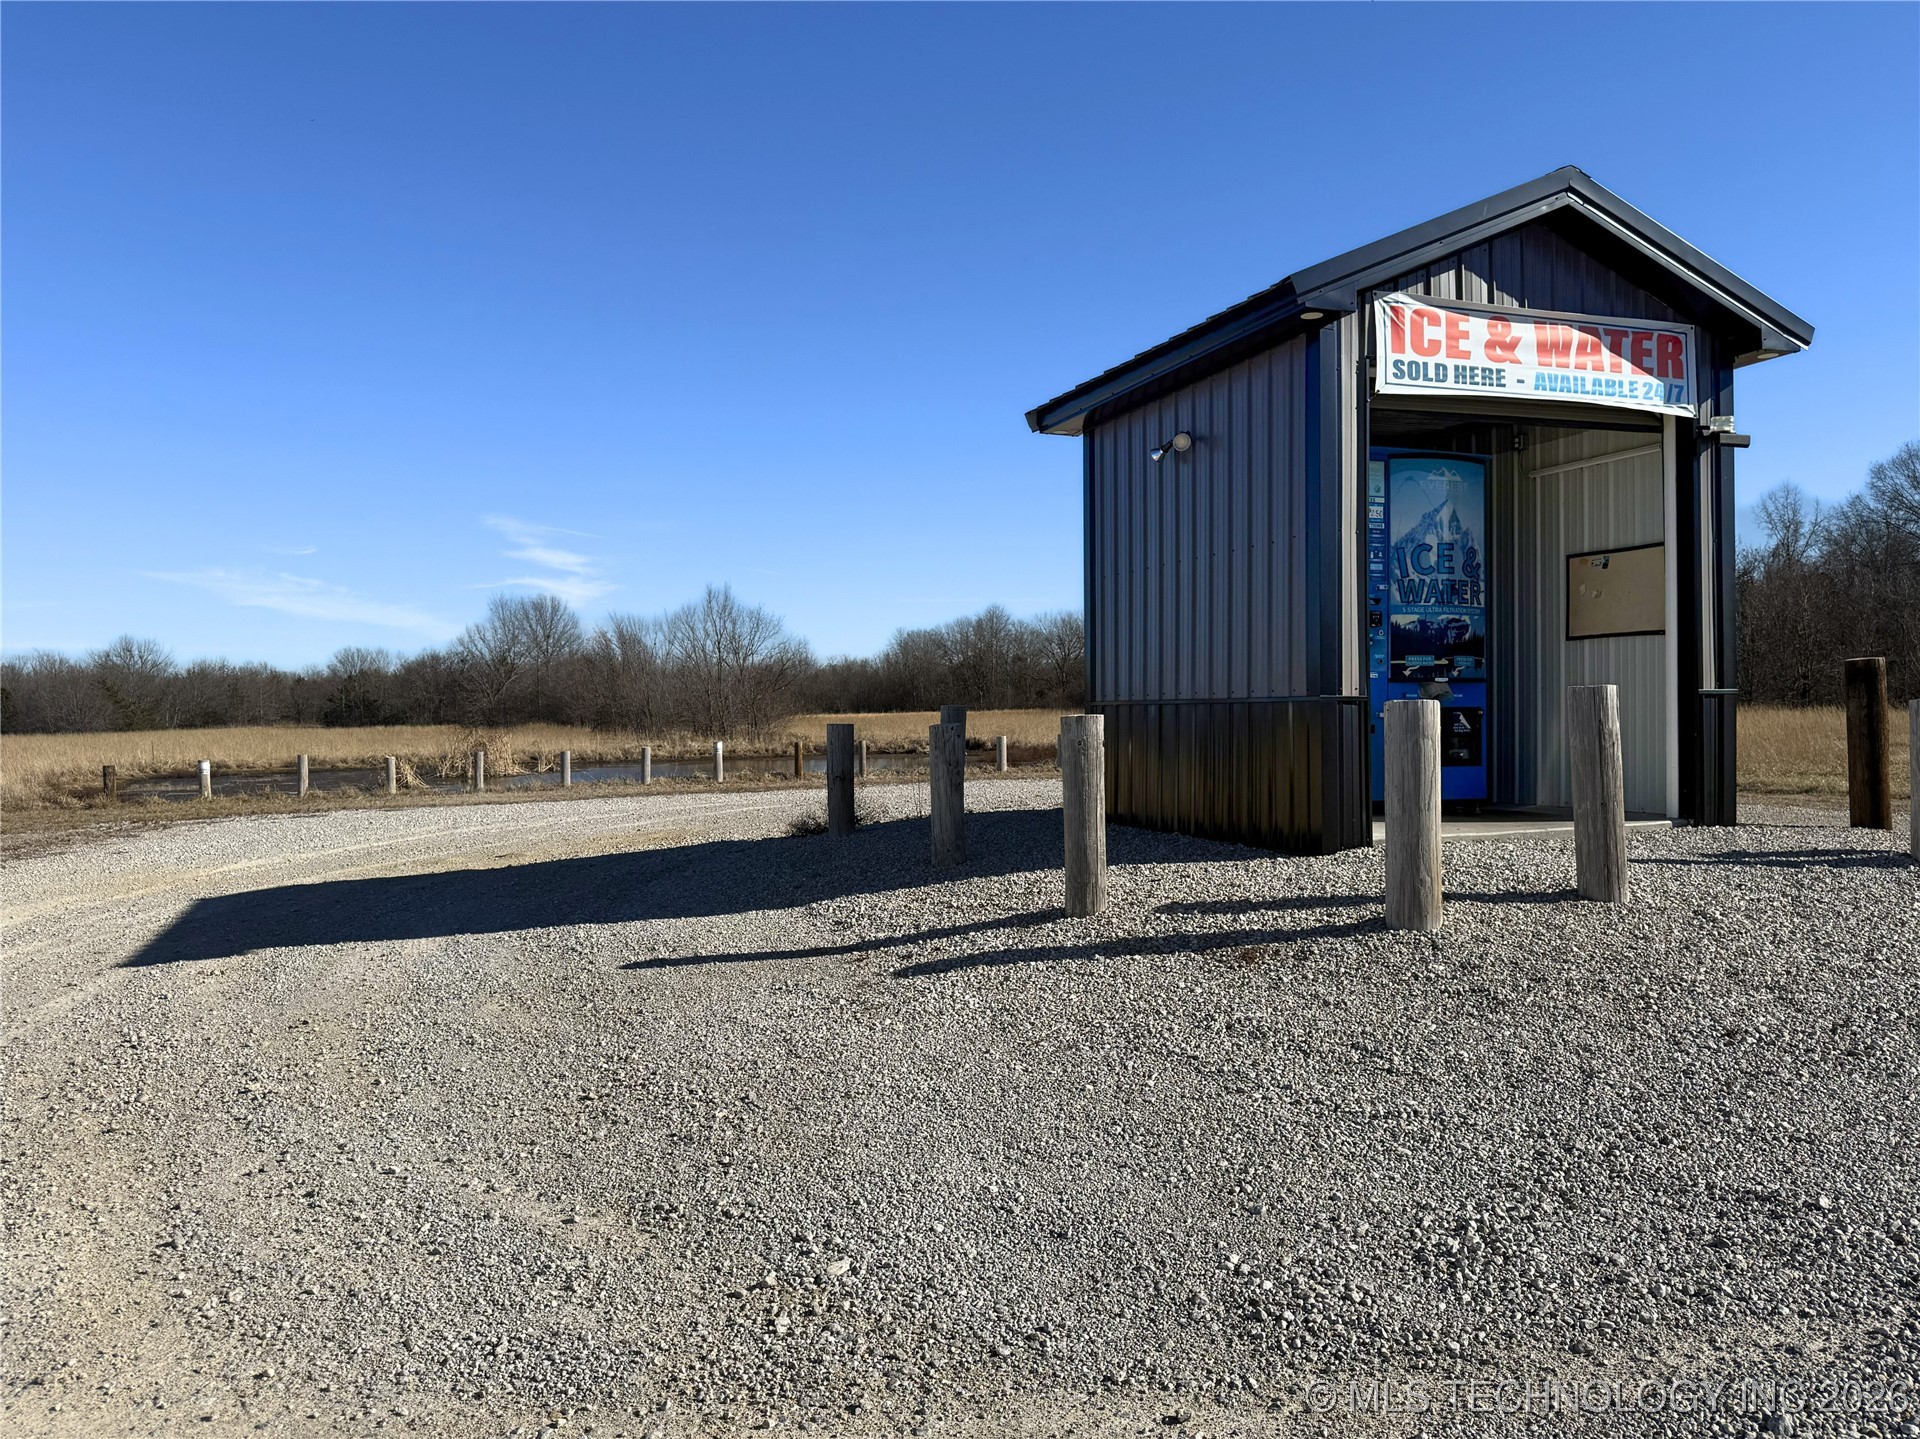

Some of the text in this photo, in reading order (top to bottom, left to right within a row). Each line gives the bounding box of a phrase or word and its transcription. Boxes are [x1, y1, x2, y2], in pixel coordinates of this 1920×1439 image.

[1389, 305, 1685, 380] ICE & WATER
[1392, 359, 1448, 383] SOLD
[1453, 364, 1507, 388] HERE
[1534, 371, 1638, 399] AVAILABLE
[1642, 381, 1685, 403] 24/7
[1420, 480, 1468, 491] EVEREST
[1396, 543, 1481, 580] ICE &
[1397, 579, 1482, 606] WATER
